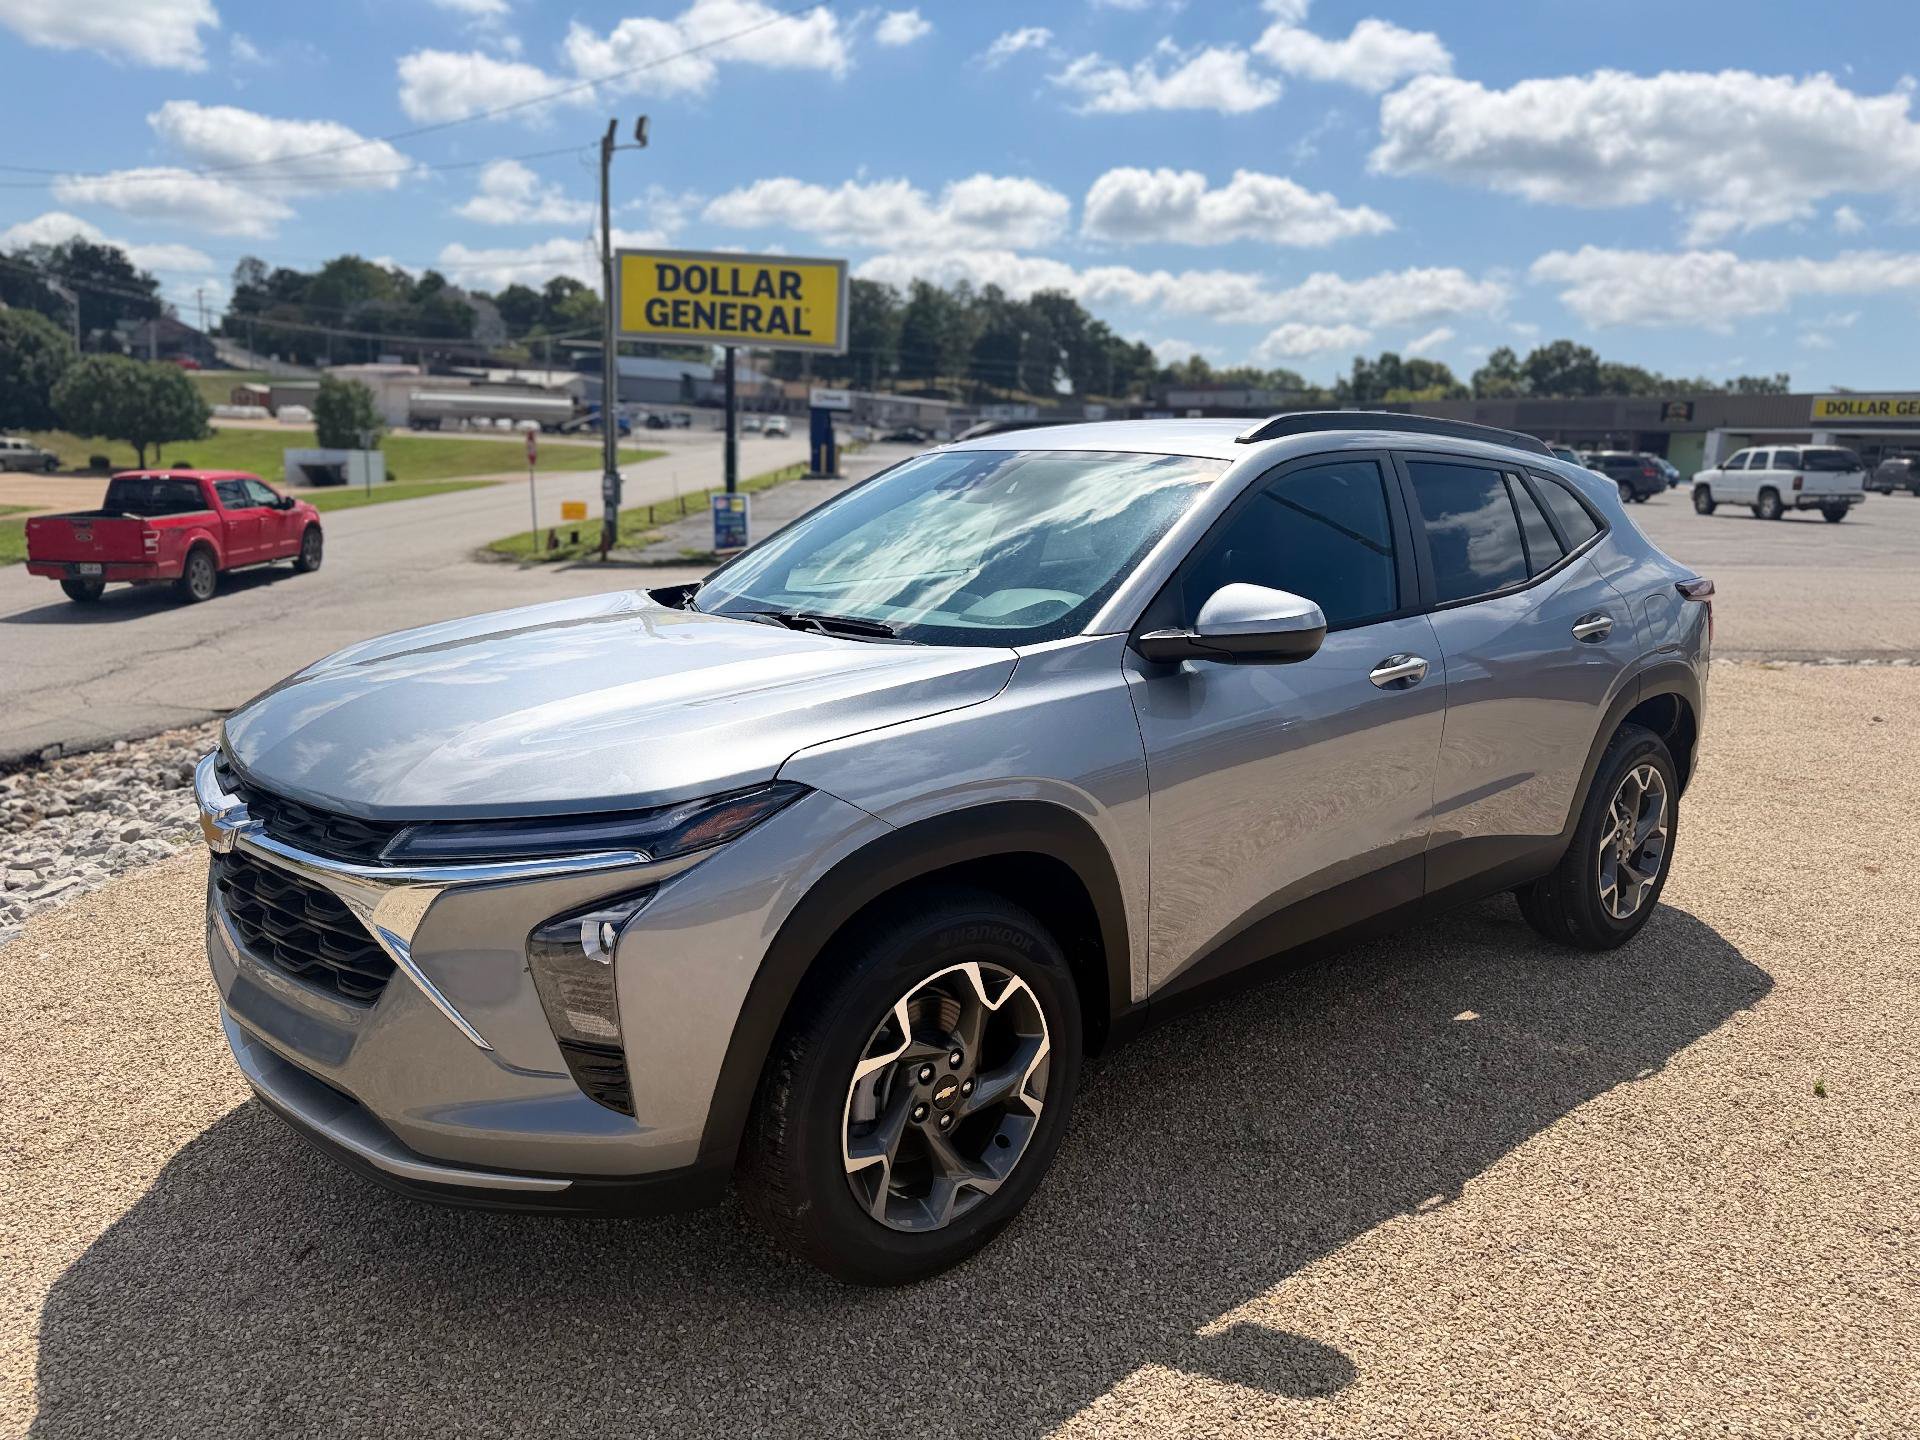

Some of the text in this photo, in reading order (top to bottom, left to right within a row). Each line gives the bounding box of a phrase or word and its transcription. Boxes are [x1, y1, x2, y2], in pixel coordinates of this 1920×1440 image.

[655, 263, 803, 300] DOLLAR
[645, 297, 812, 336] GENERAL
[1825, 400, 1920, 415] DOLLAR GE
